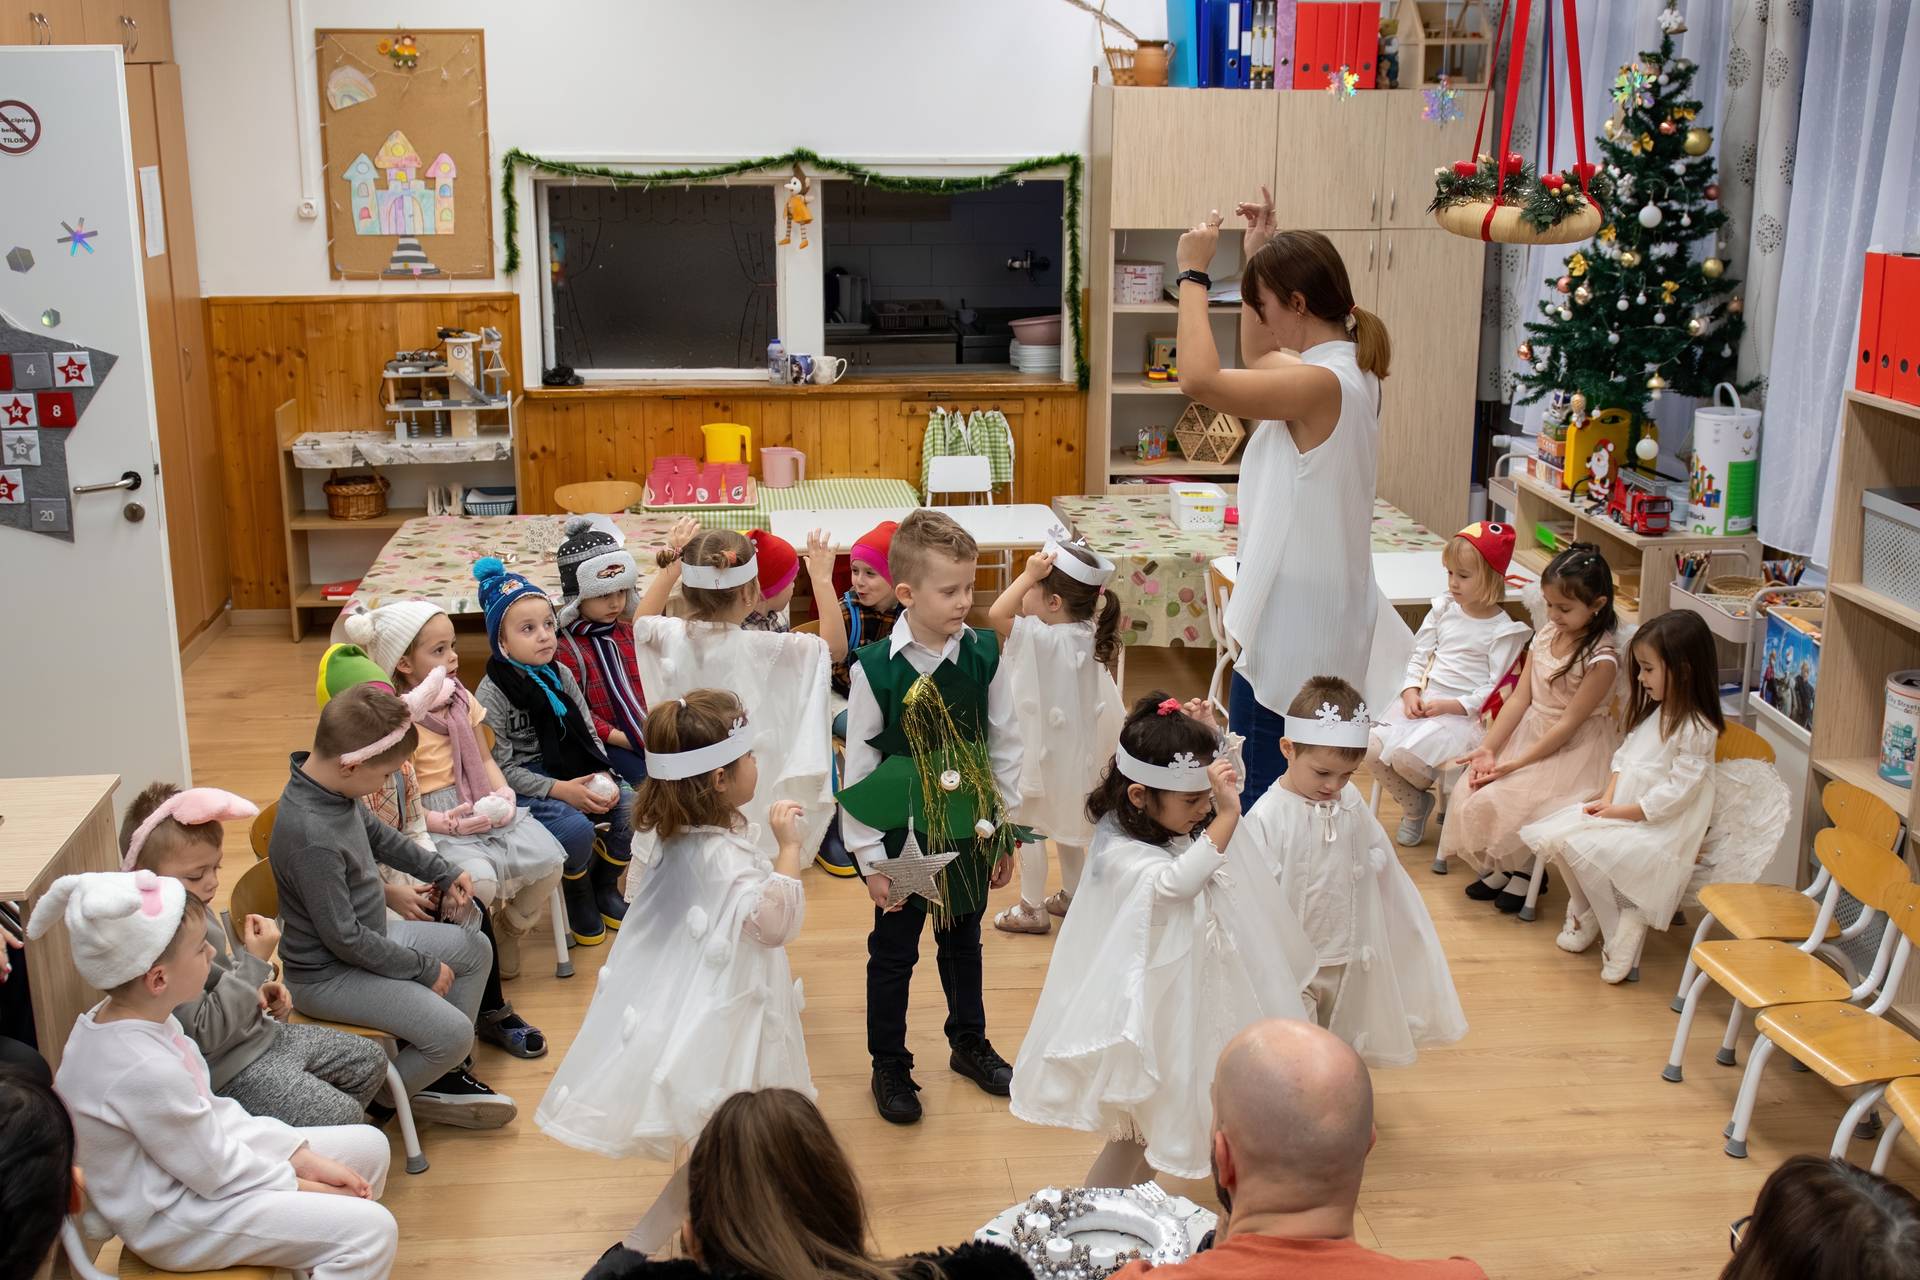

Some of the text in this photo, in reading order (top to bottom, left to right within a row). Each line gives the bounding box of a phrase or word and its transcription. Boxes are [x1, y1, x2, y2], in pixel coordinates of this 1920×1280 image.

[26, 364, 36, 376] 4
[65, 365, 80, 378] 15
[9, 406, 23, 418] 14
[52, 404, 62, 417] 8
[13, 443, 28, 455] 16
[0, 483, 9, 495] 5
[40, 510, 55, 522] 20
